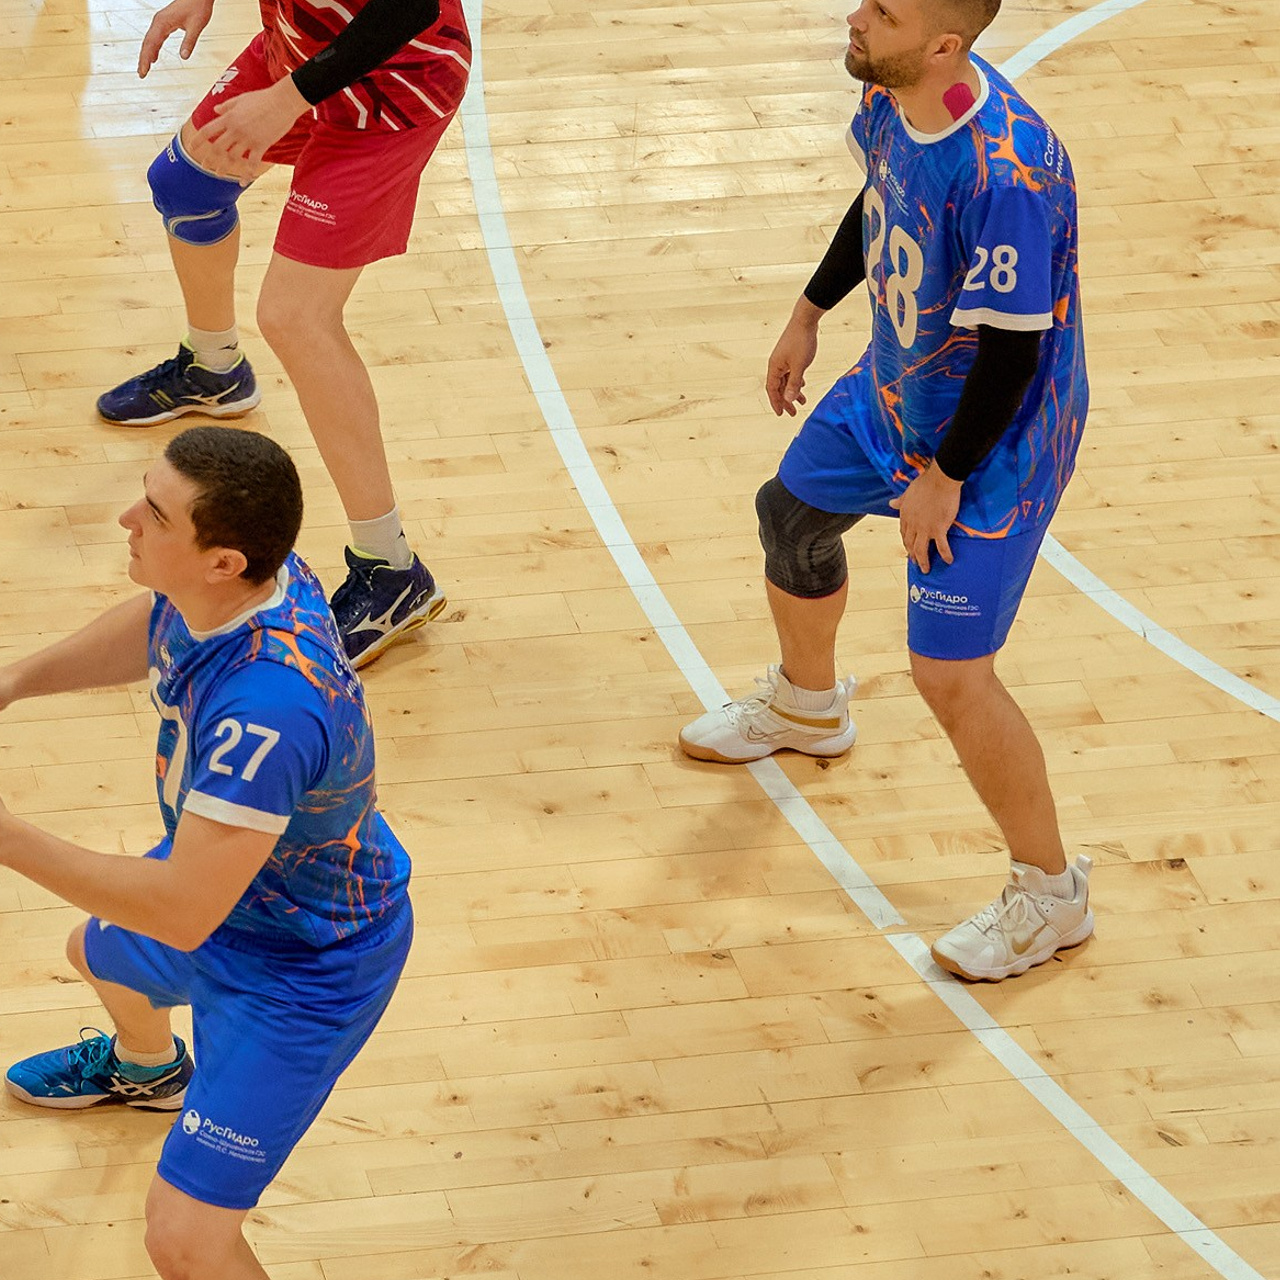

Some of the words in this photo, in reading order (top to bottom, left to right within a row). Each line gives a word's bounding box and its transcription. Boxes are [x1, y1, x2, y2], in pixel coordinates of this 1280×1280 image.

[962, 244, 1019, 294] 28
[208, 717, 281, 782] 27
[202, 1118, 259, 1147] РусГидро
